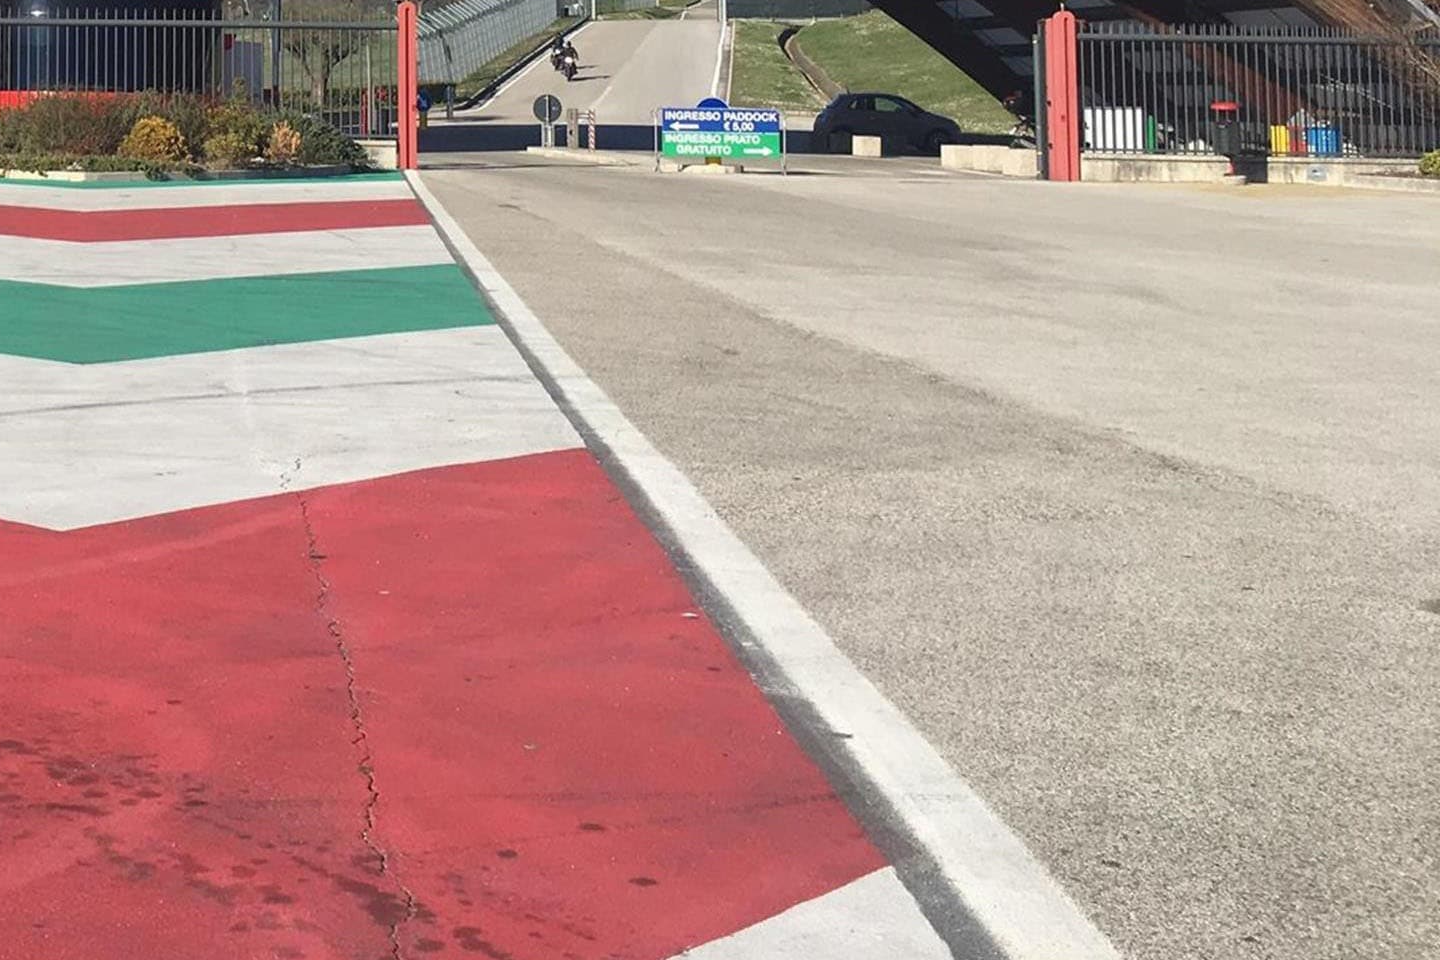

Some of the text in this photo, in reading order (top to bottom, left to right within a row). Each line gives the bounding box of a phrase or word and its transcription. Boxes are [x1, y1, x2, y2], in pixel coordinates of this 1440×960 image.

[664, 111, 777, 123] INGRESSO PADDOCK
[664, 133, 760, 144] INGRESSO PRATO
[675, 144, 733, 155] GRATUITO
